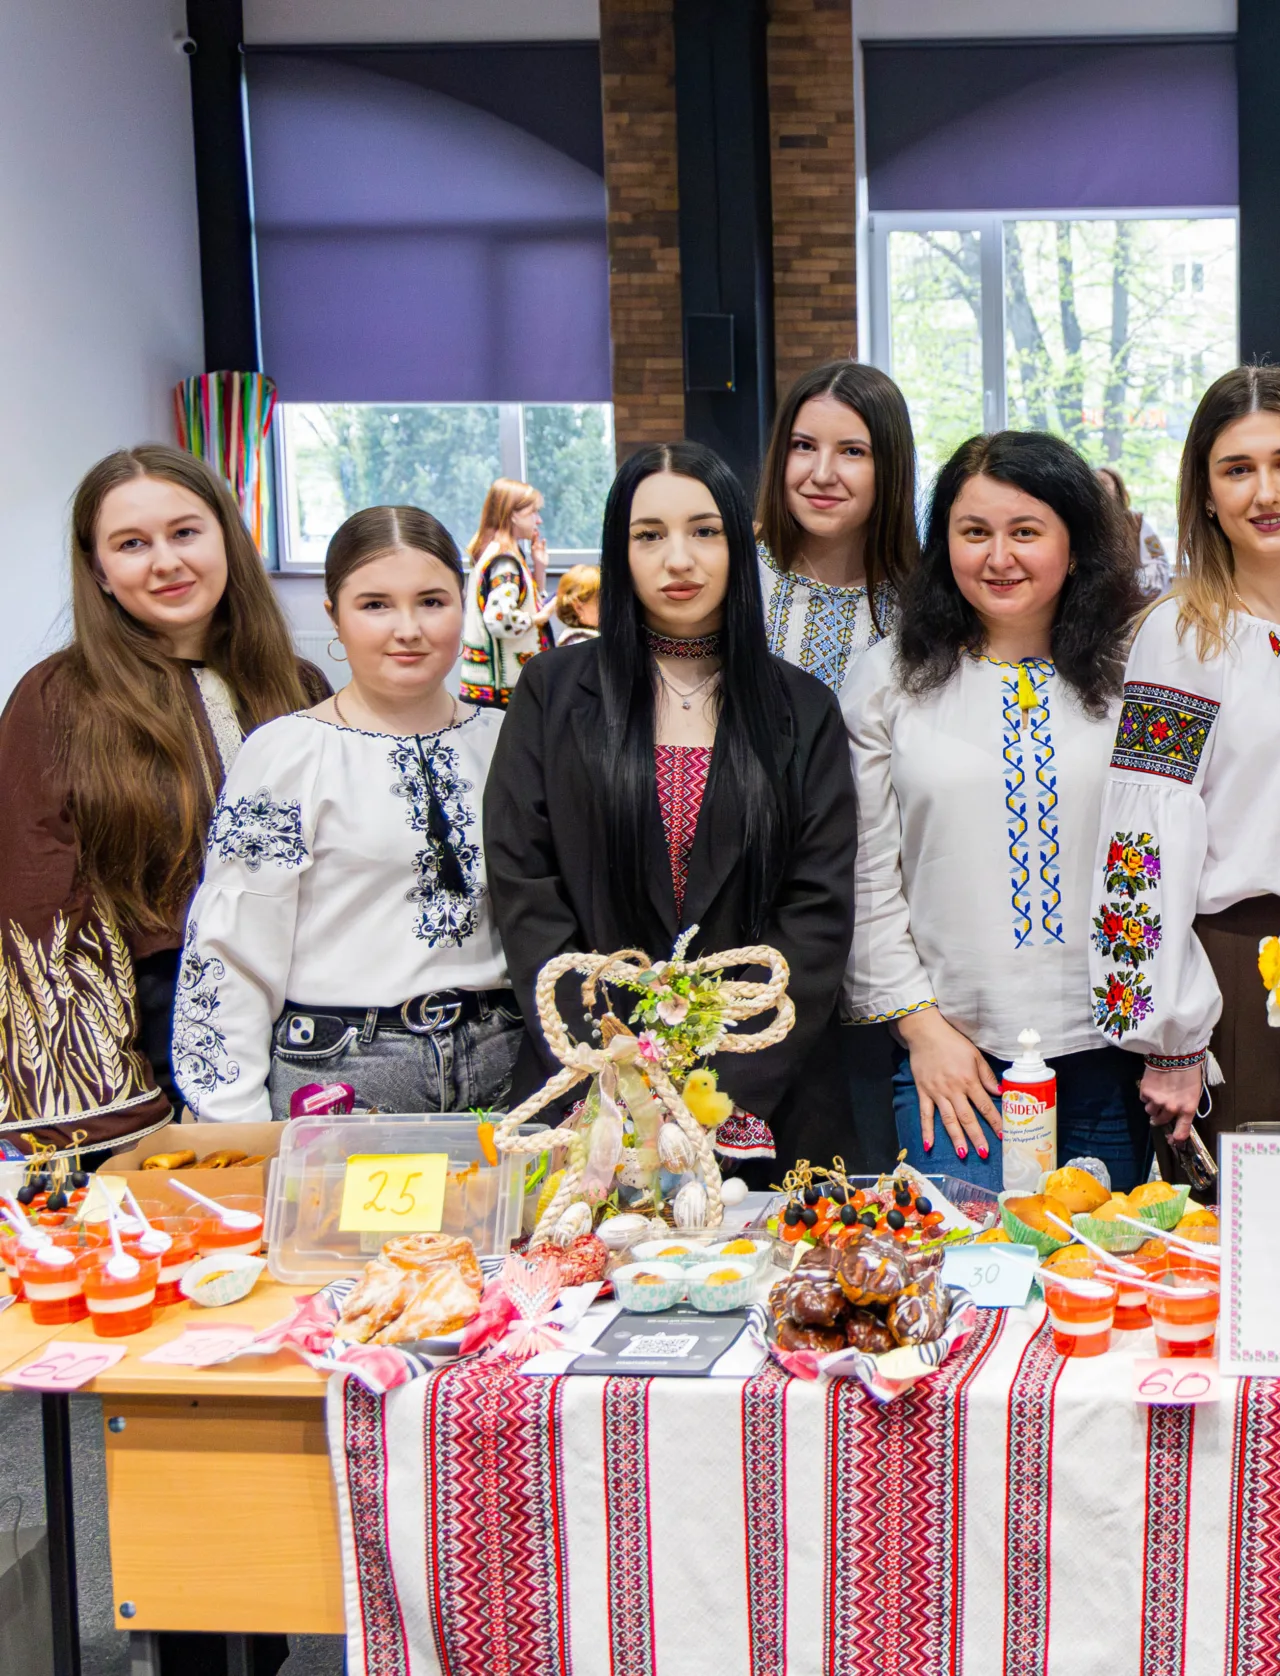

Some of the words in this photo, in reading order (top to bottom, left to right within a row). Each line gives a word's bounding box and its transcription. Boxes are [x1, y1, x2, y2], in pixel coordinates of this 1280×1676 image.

[362, 1169, 423, 1216] 25
[968, 1263, 1000, 1288] 30
[19, 1352, 110, 1382] 60
[1138, 1367, 1212, 1399] 60
